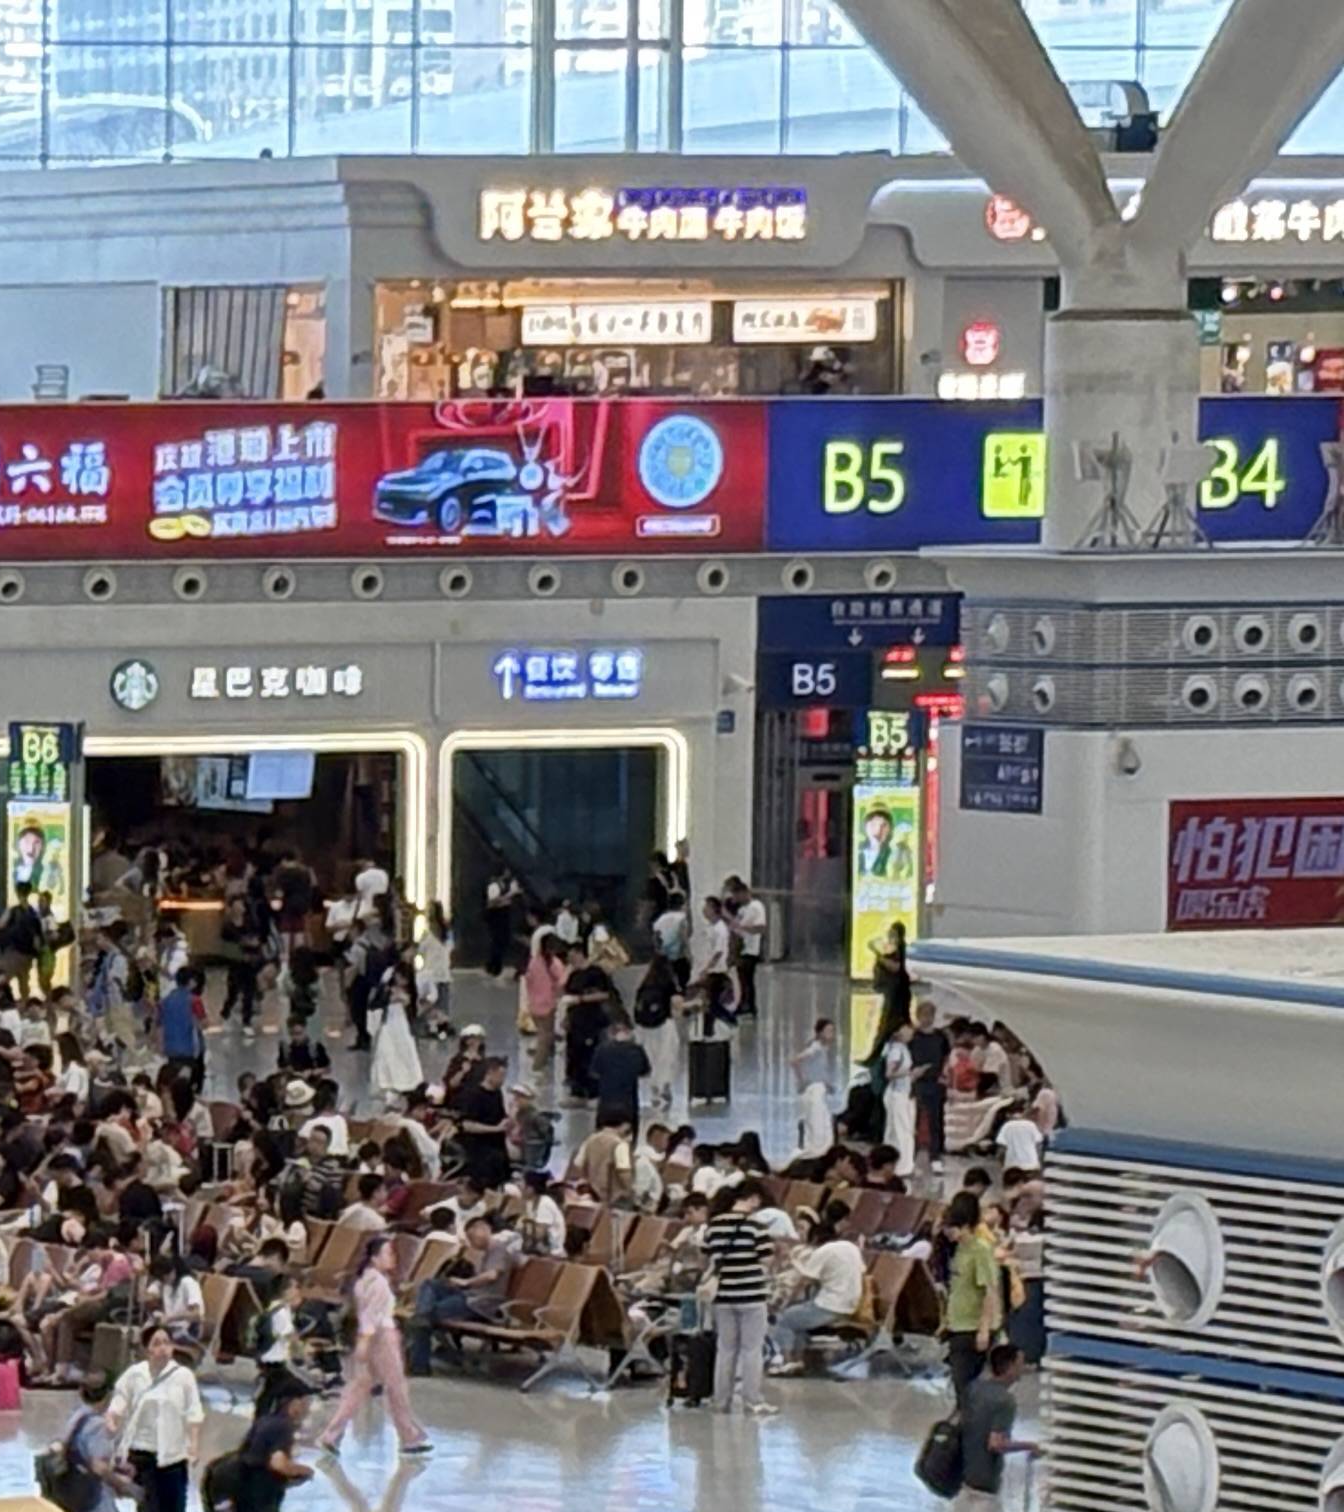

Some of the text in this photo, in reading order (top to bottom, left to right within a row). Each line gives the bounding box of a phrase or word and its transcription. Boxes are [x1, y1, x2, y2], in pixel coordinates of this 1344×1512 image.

[824, 440, 904, 514] B5
[191, 665, 363, 698] 星巴克咖啡
[792, 663, 837, 696] B5
[22, 732, 60, 764] B6
[869, 718, 909, 750] B5
[1172, 816, 1344, 883] 怕犯困
